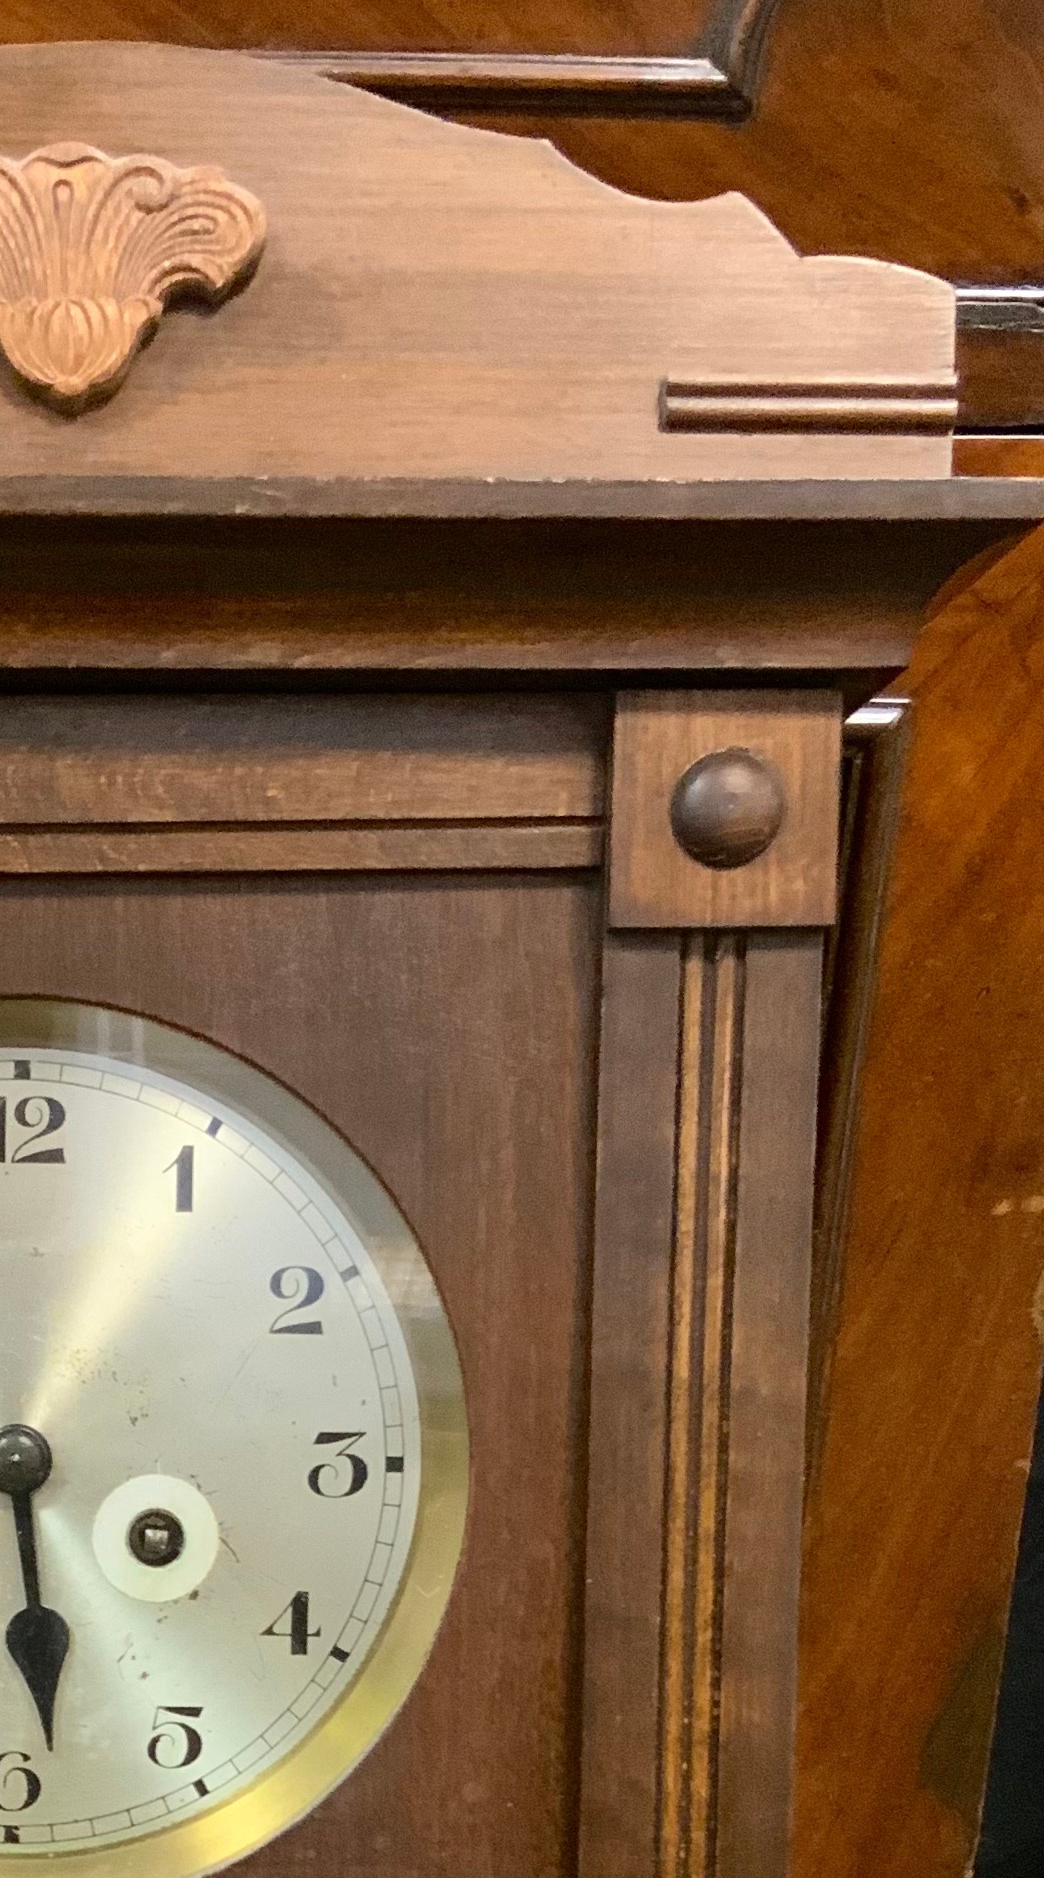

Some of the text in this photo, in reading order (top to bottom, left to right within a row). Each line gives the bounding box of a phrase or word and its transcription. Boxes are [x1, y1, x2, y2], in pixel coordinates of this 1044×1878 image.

[162, 1145, 194, 1213] 1
[269, 1266, 325, 1335] 2
[307, 1432, 367, 1498] 3
[260, 1591, 321, 1655] 4
[147, 1705, 204, 1770] 5
